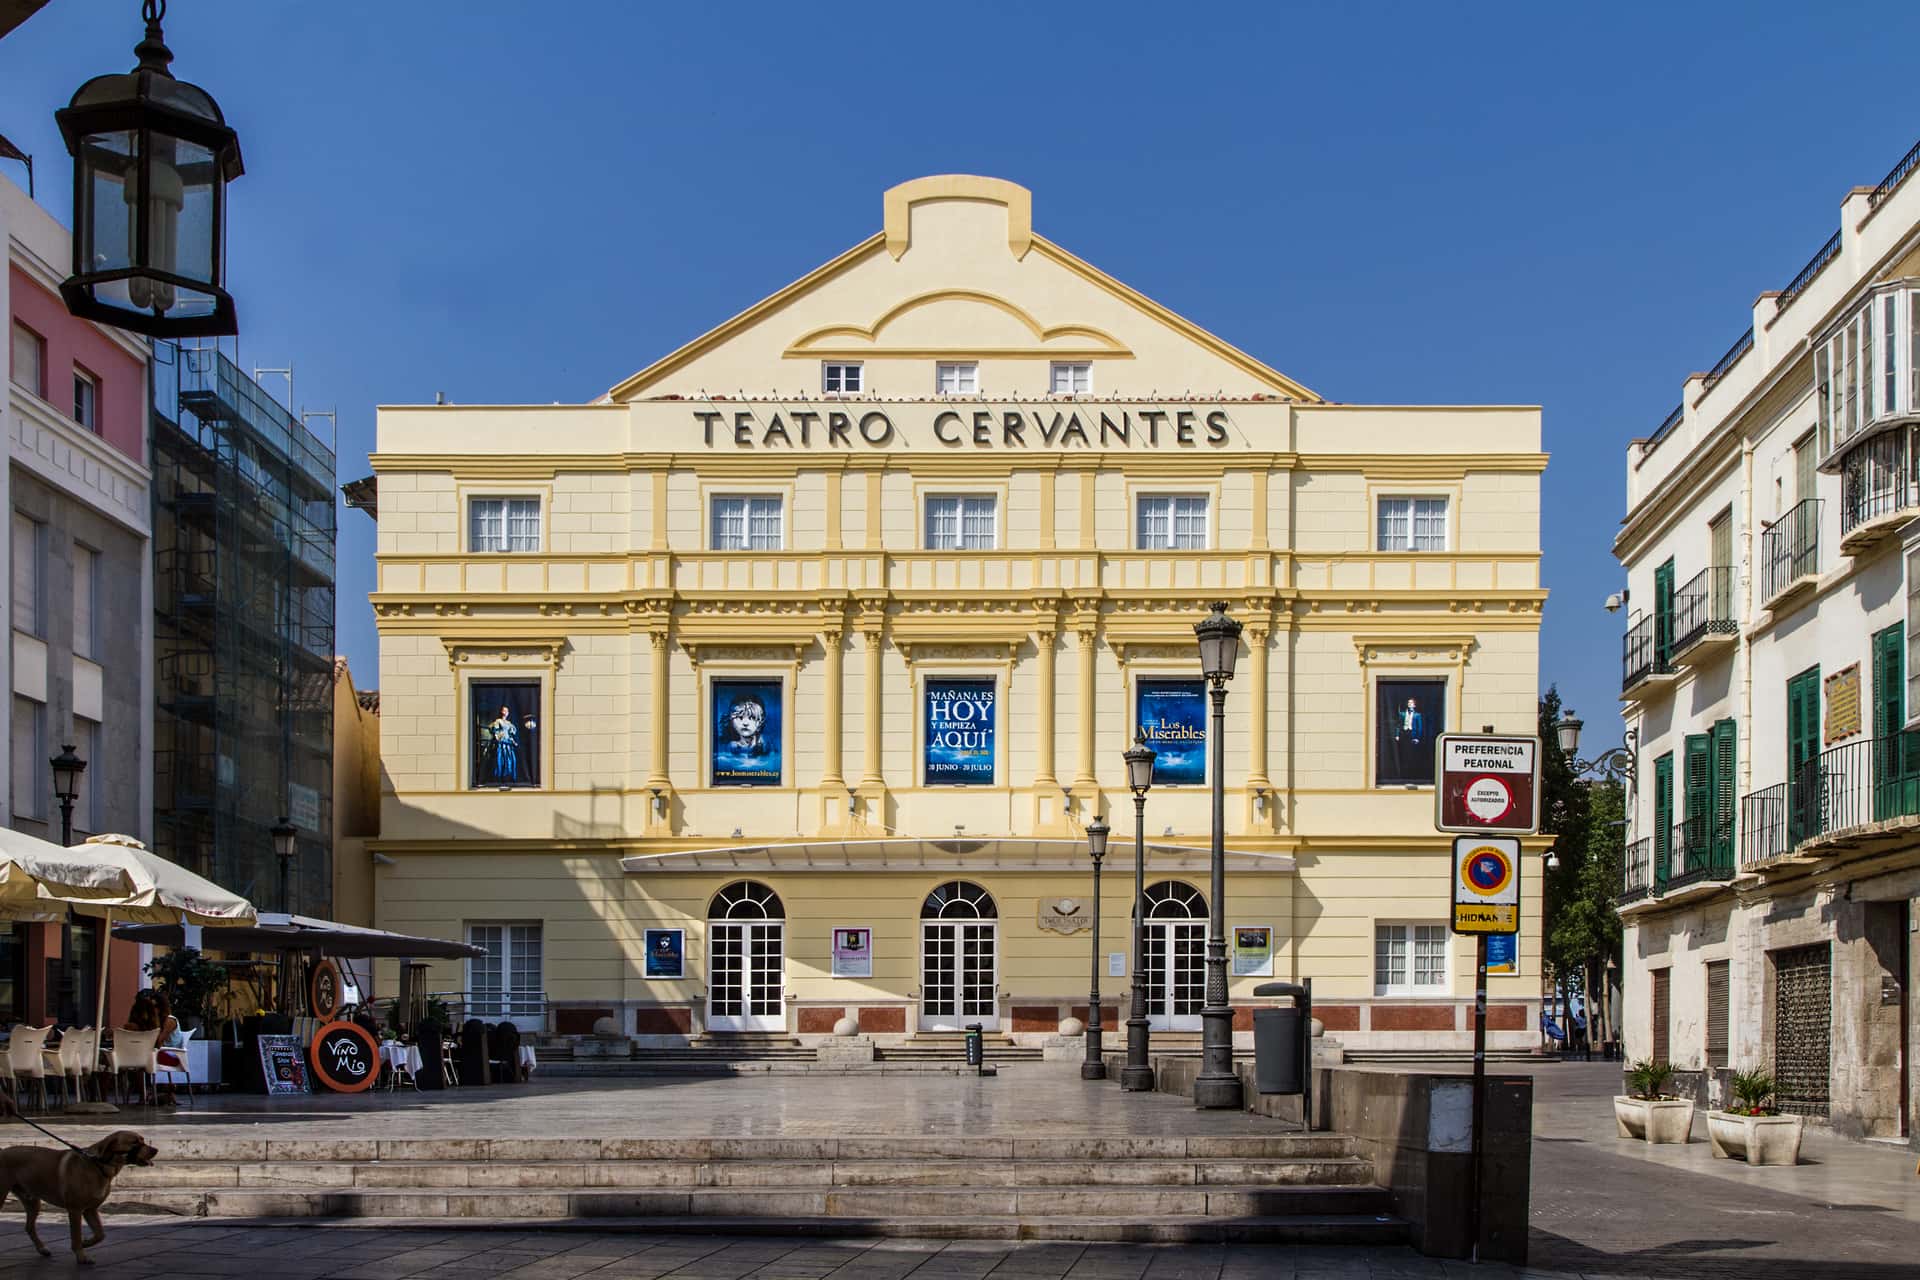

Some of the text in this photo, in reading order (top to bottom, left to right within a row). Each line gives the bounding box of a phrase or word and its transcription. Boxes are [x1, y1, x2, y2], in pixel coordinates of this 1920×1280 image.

[693, 410, 1229, 444] TEATRO CERVANTES
[981, 691, 993, 701] ES
[931, 700, 993, 721] HOY
[931, 721, 976, 729] Y EMPIEZA
[1455, 745, 1524, 755] PREFERENCIA
[936, 764, 959, 772] JUNIO
[971, 764, 993, 772] JULIO
[1464, 759, 1514, 769] PEATONAL
